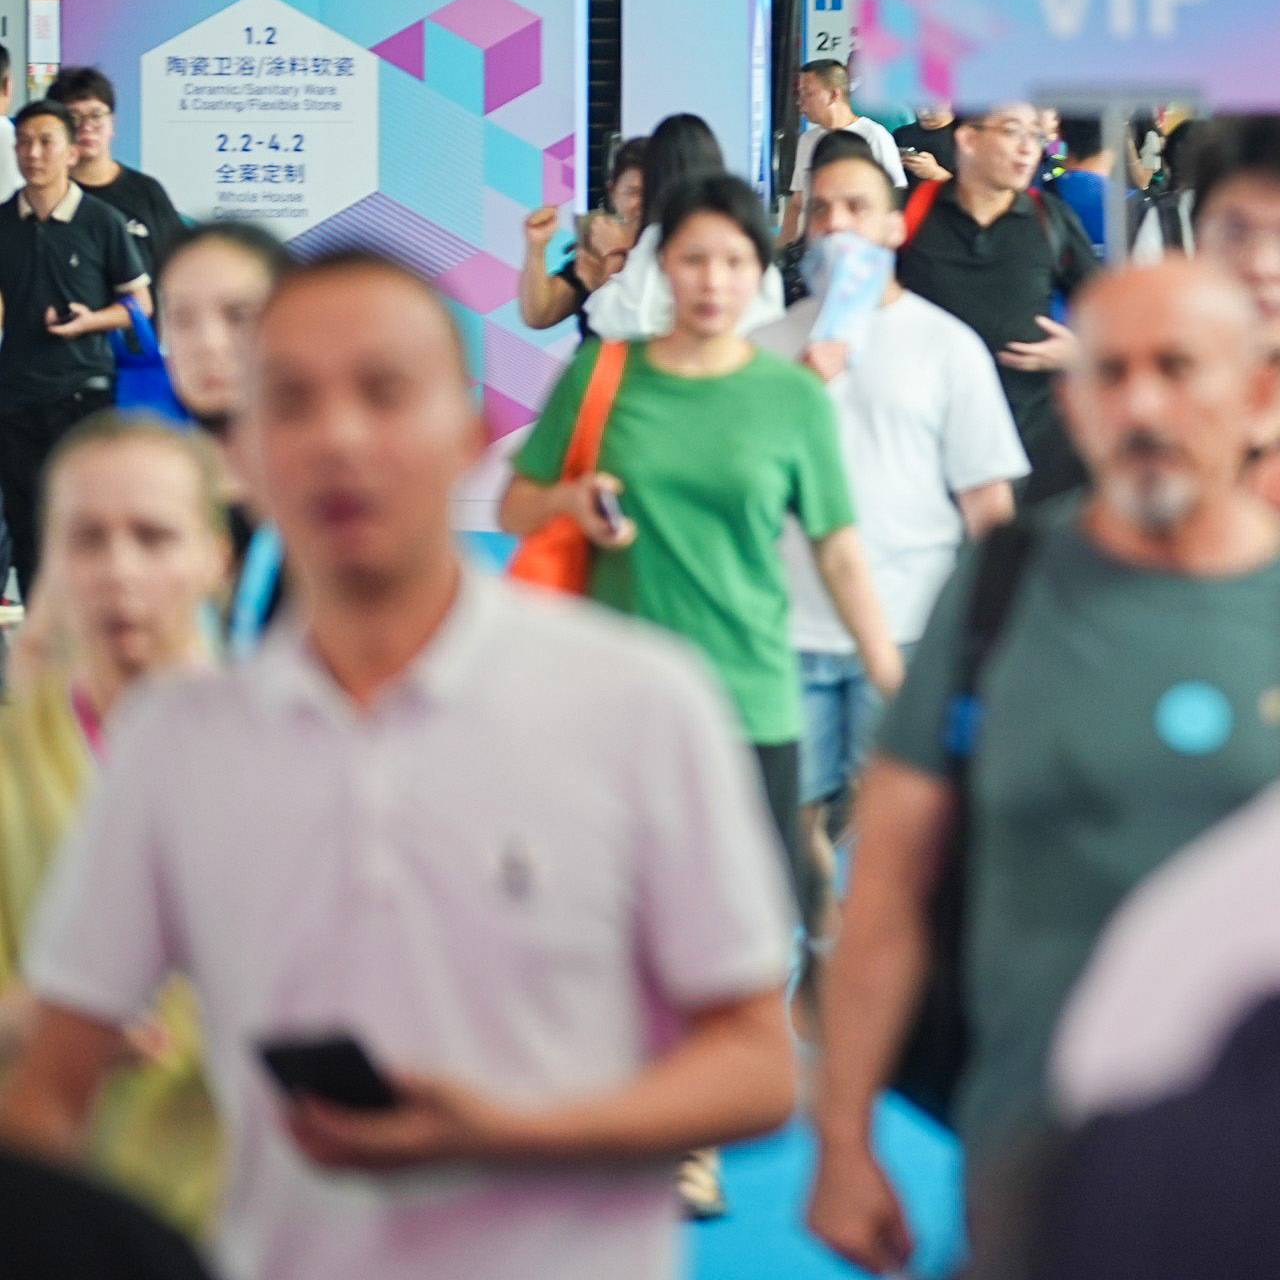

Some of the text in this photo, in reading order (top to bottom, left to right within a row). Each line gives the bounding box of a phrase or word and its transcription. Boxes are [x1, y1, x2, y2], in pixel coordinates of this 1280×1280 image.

[244, 27, 277, 44] 1.2
[815, 31, 842, 51] 2F
[216, 133, 305, 152] 2.2-4.2
[216, 163, 305, 184] 全案定制
